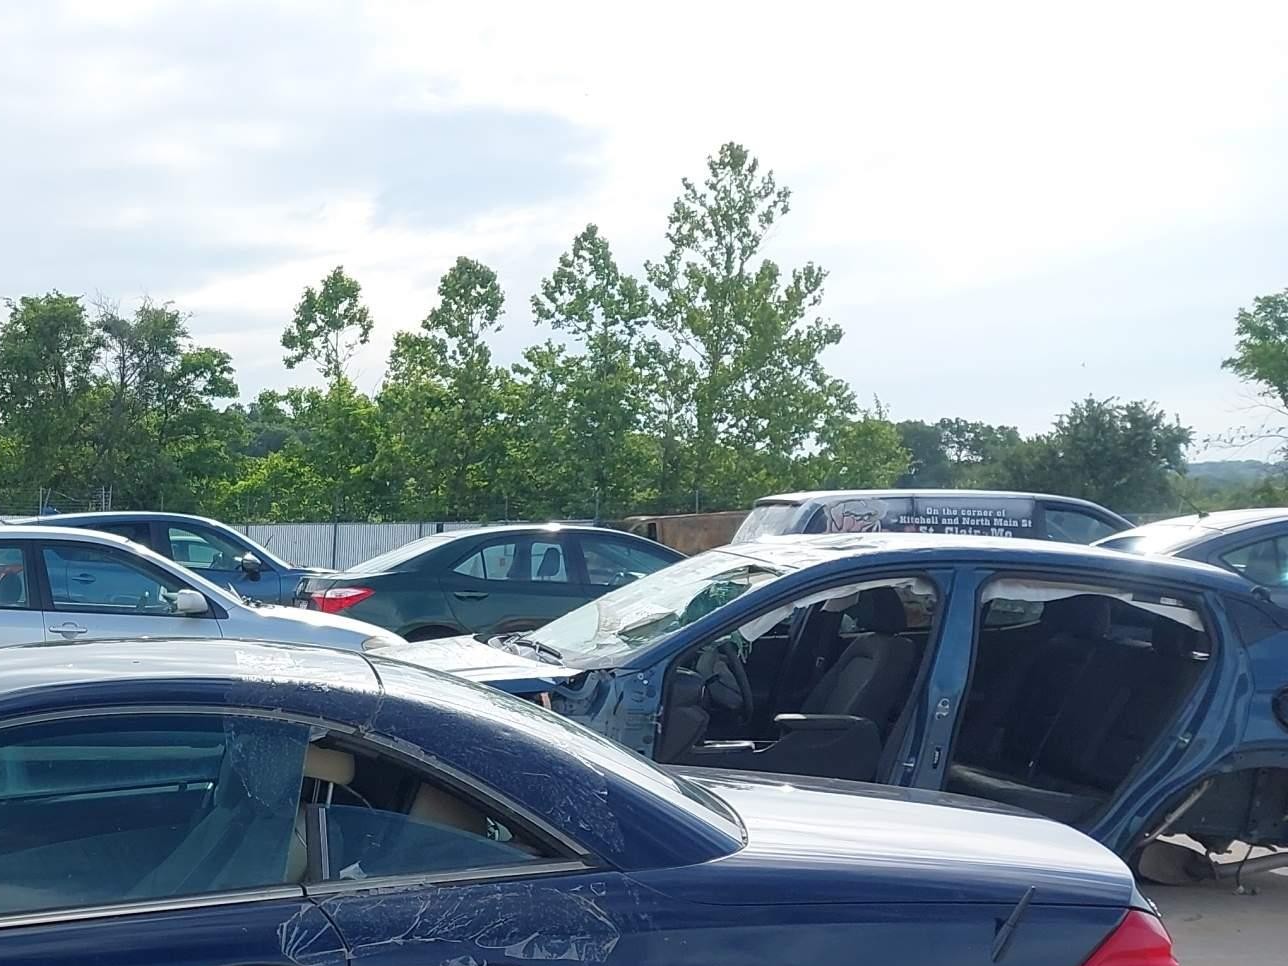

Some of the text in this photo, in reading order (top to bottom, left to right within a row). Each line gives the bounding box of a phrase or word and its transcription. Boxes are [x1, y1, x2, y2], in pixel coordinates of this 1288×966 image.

[926, 507, 1006, 517] On the corner of
[941, 516, 959, 525] and
[961, 516, 991, 526] North
[993, 518, 1019, 527] Main
[1021, 519, 1033, 528] St
